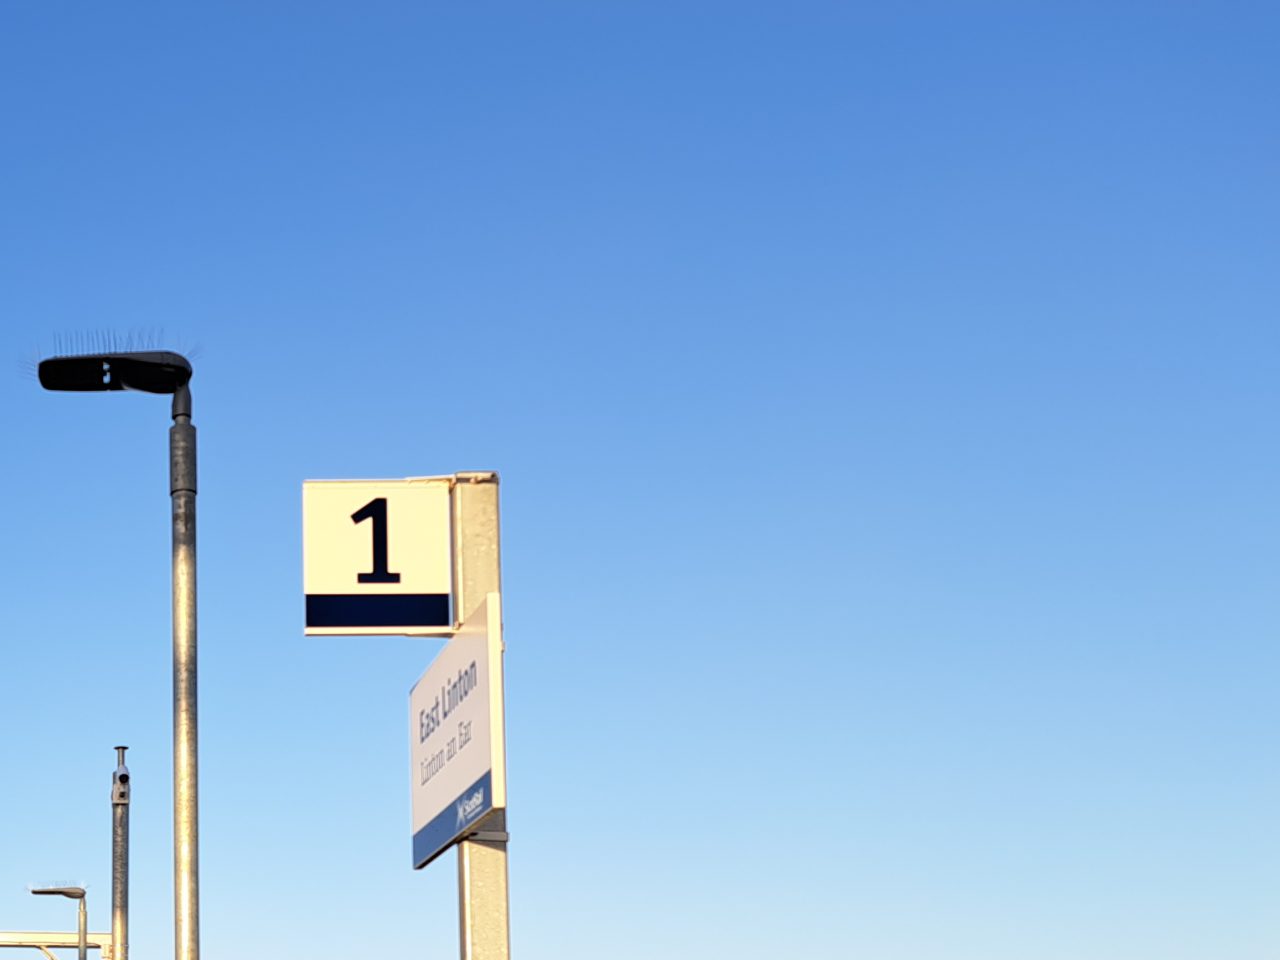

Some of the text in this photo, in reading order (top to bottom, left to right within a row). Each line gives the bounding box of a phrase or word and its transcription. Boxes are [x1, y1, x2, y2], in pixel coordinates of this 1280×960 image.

[351, 497, 401, 583] 1
[419, 659, 477, 744] East Linton
[420, 720, 472, 786] Linton an Ear
